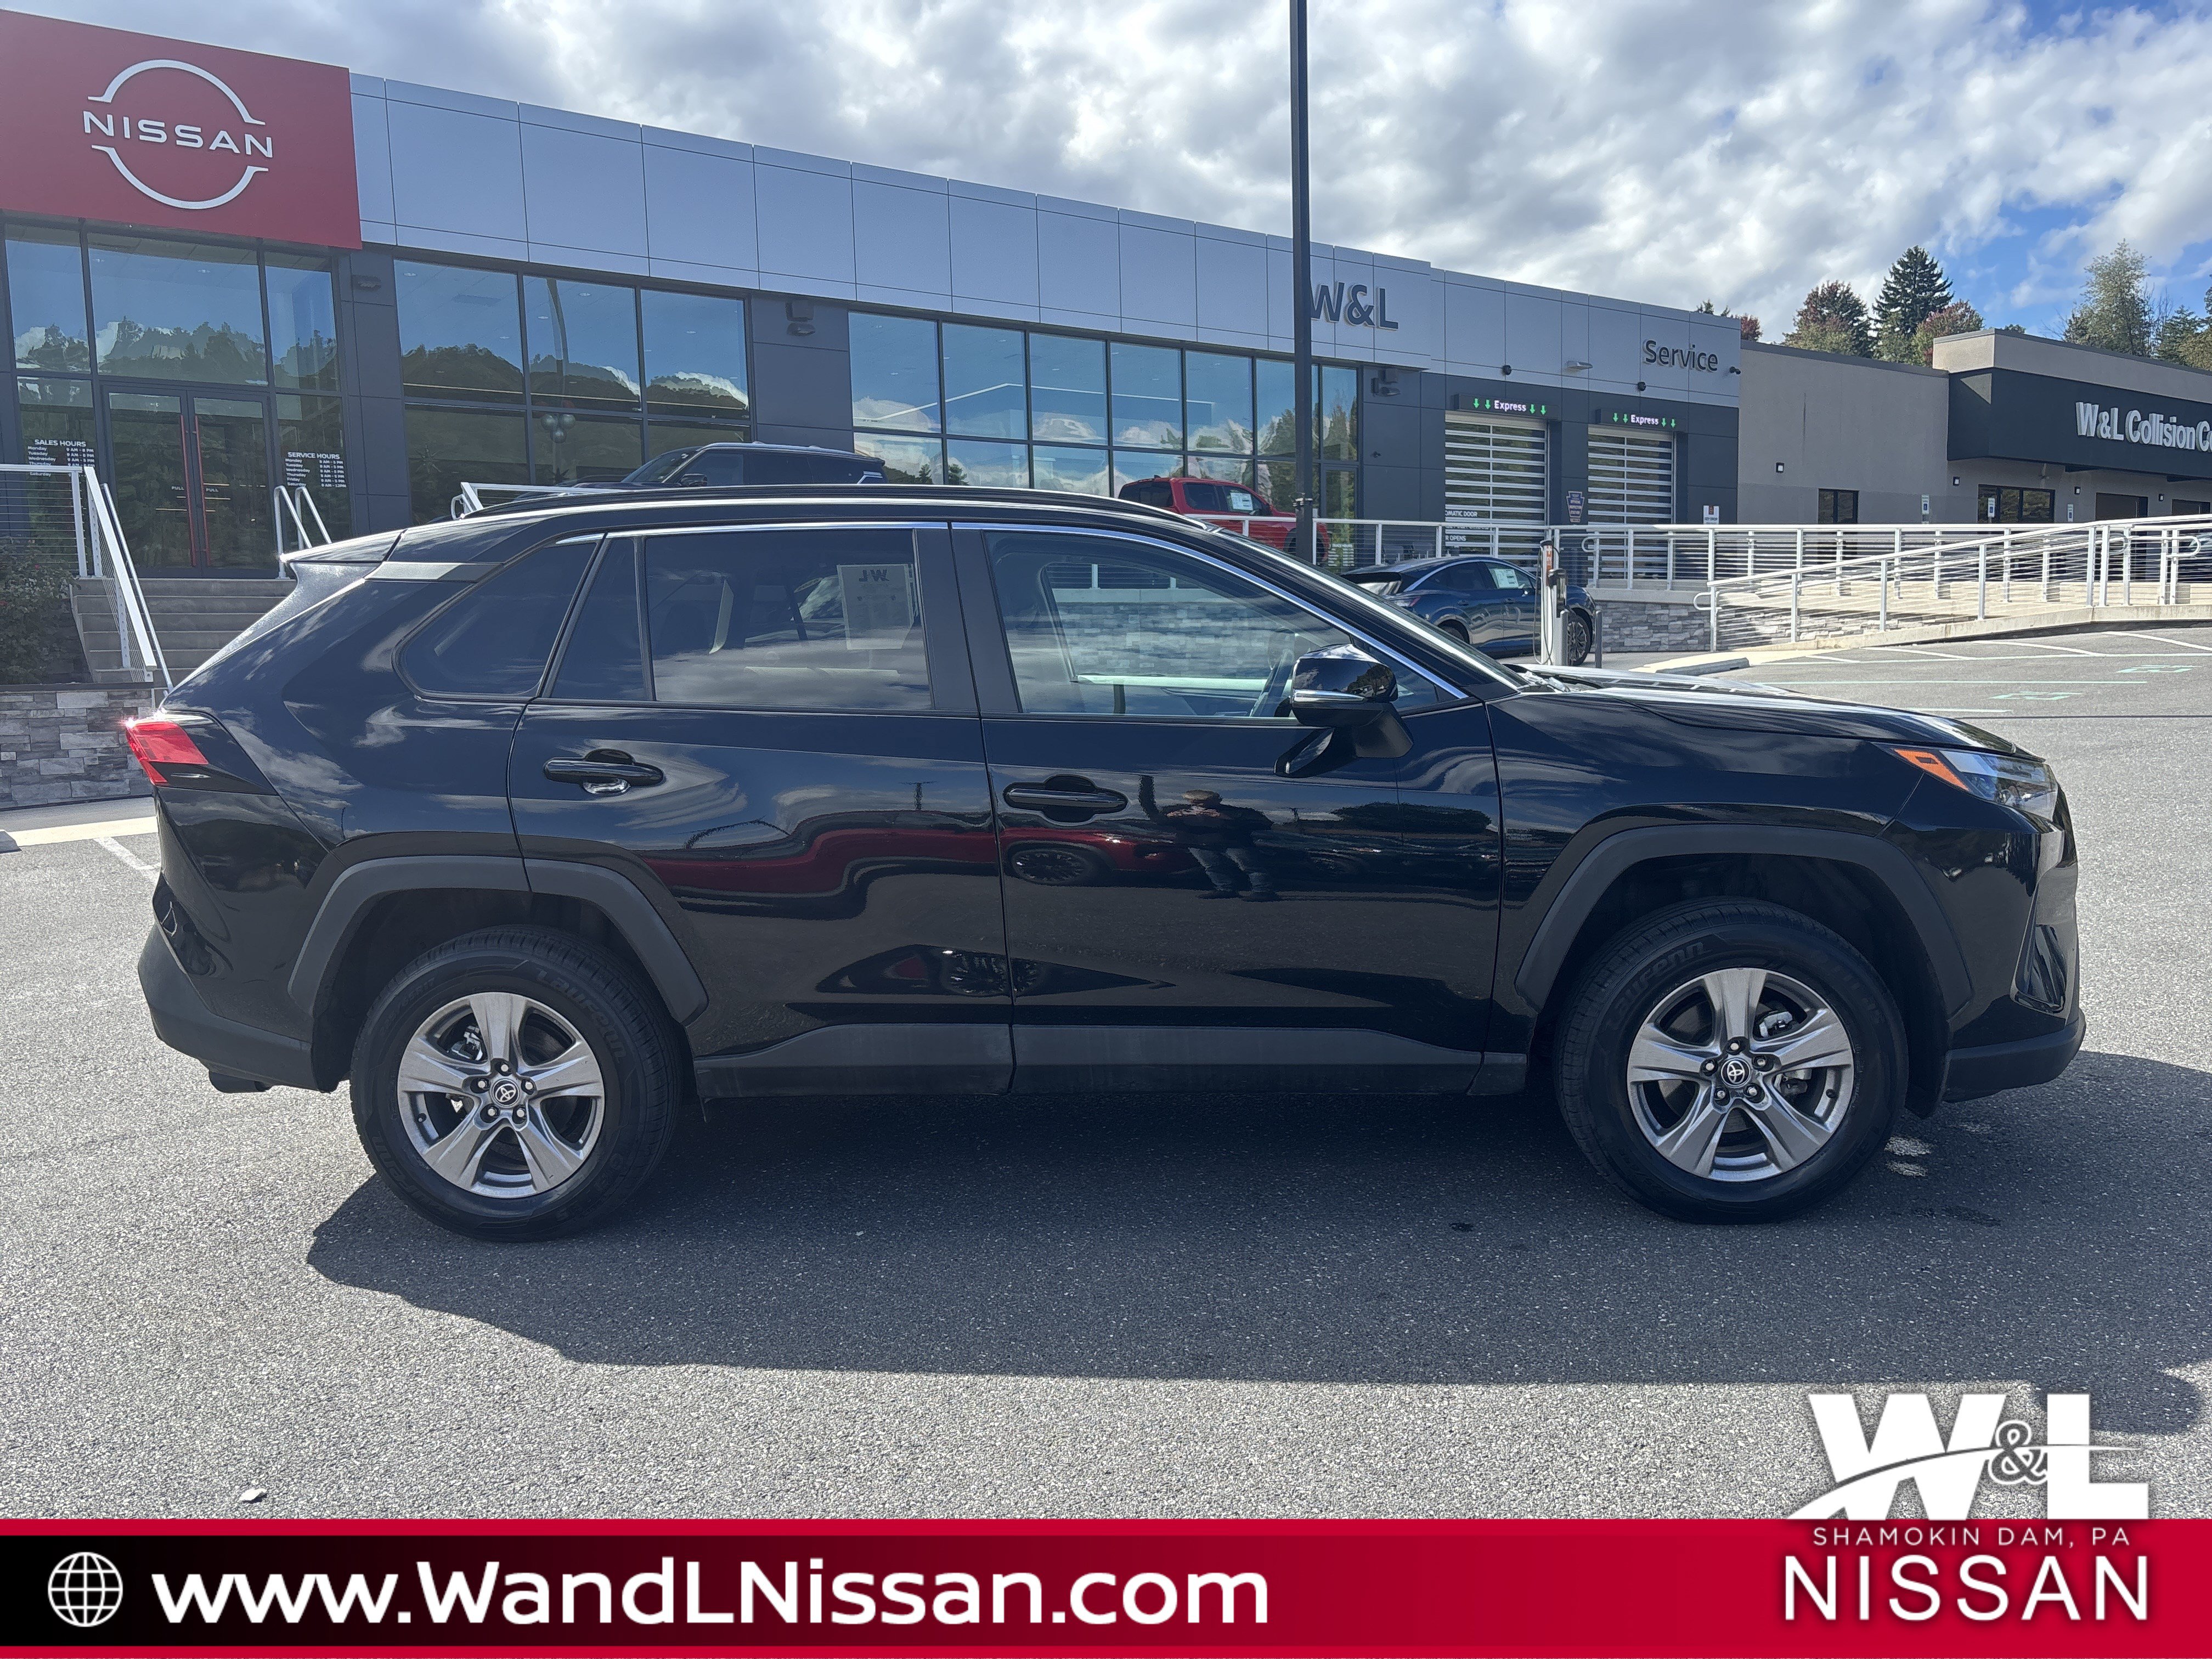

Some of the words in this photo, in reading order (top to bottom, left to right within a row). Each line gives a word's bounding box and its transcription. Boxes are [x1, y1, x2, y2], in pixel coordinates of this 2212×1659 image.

[83, 110, 273, 158] NISSAN
[1310, 282, 1399, 330] W&L
[1643, 340, 1719, 373] Service
[1494, 400, 1527, 413] Express
[1630, 414, 1659, 426] Express
[2075, 402, 2124, 441] W&L
[2125, 410, 2196, 450] Collision
